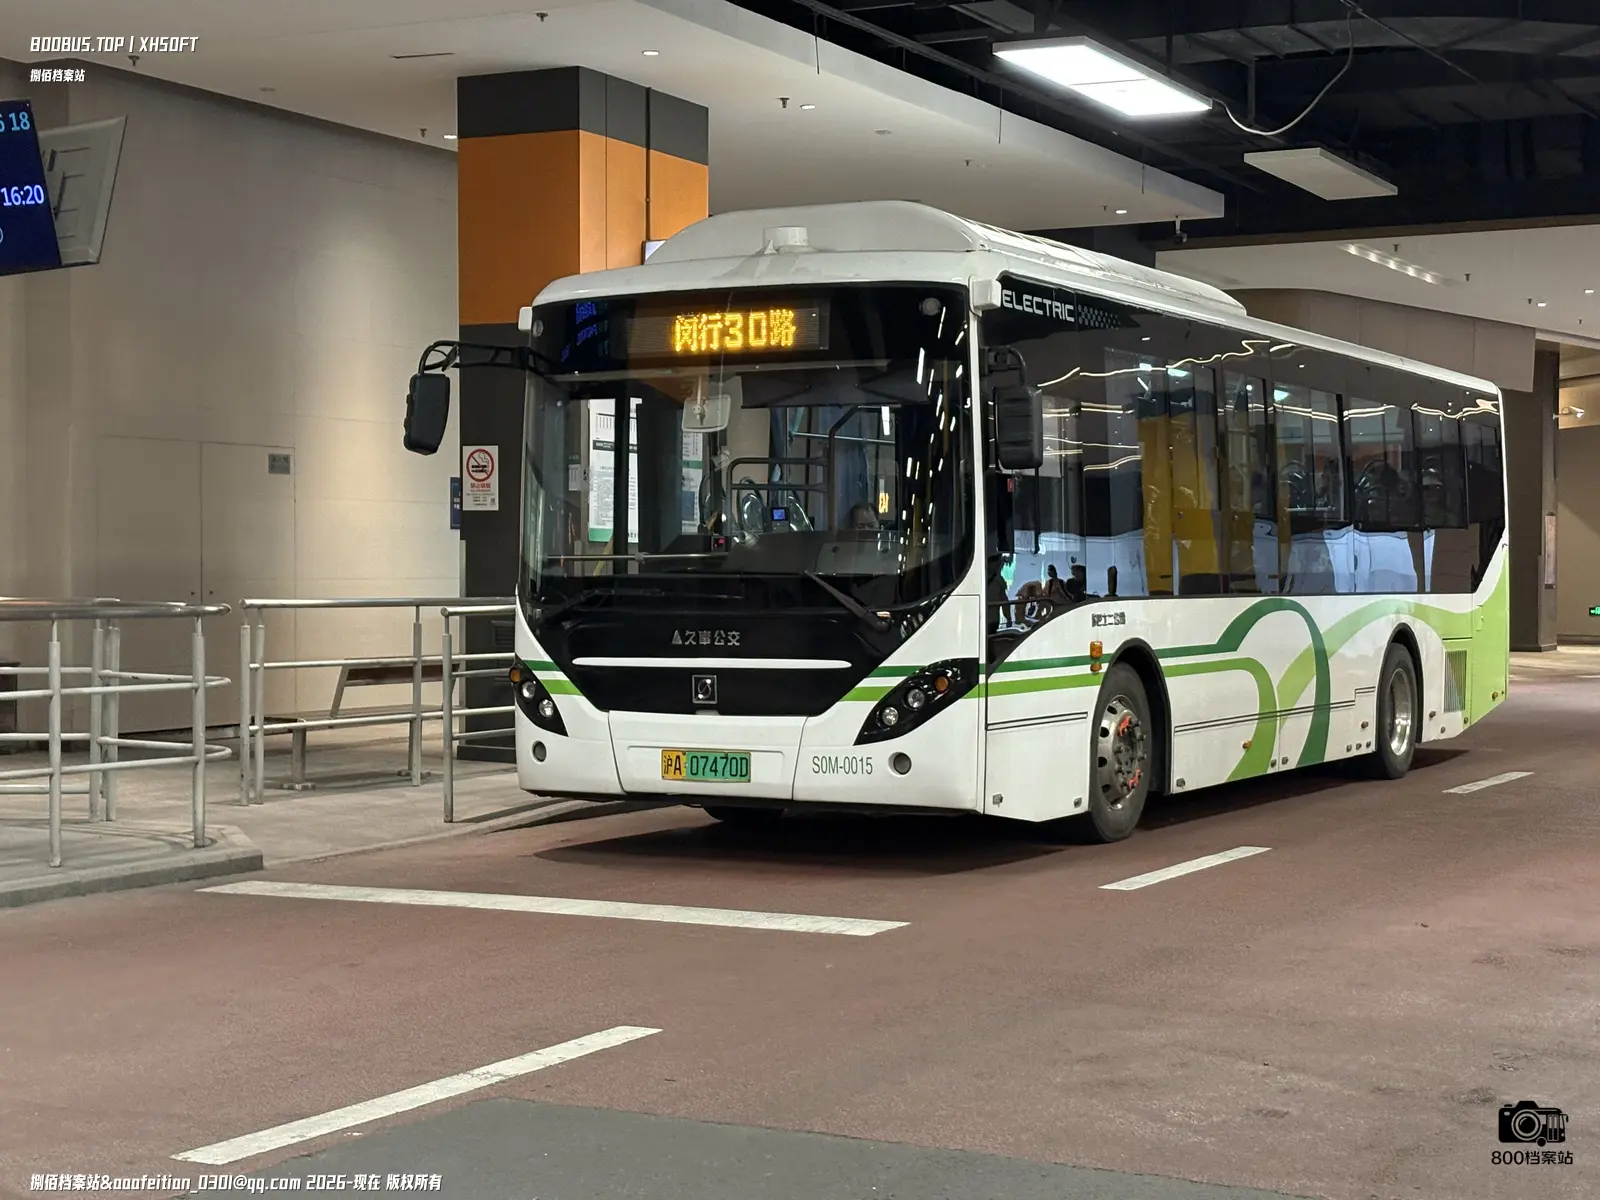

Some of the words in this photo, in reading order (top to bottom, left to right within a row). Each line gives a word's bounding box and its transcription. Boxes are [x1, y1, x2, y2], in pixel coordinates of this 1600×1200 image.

[8, 111, 31, 131] 18
[0, 184, 45, 207] 16:20
[1002, 289, 1075, 322] ELECTRIC
[675, 309, 797, 352] 闵行30路
[684, 629, 740, 646] 久事公交
